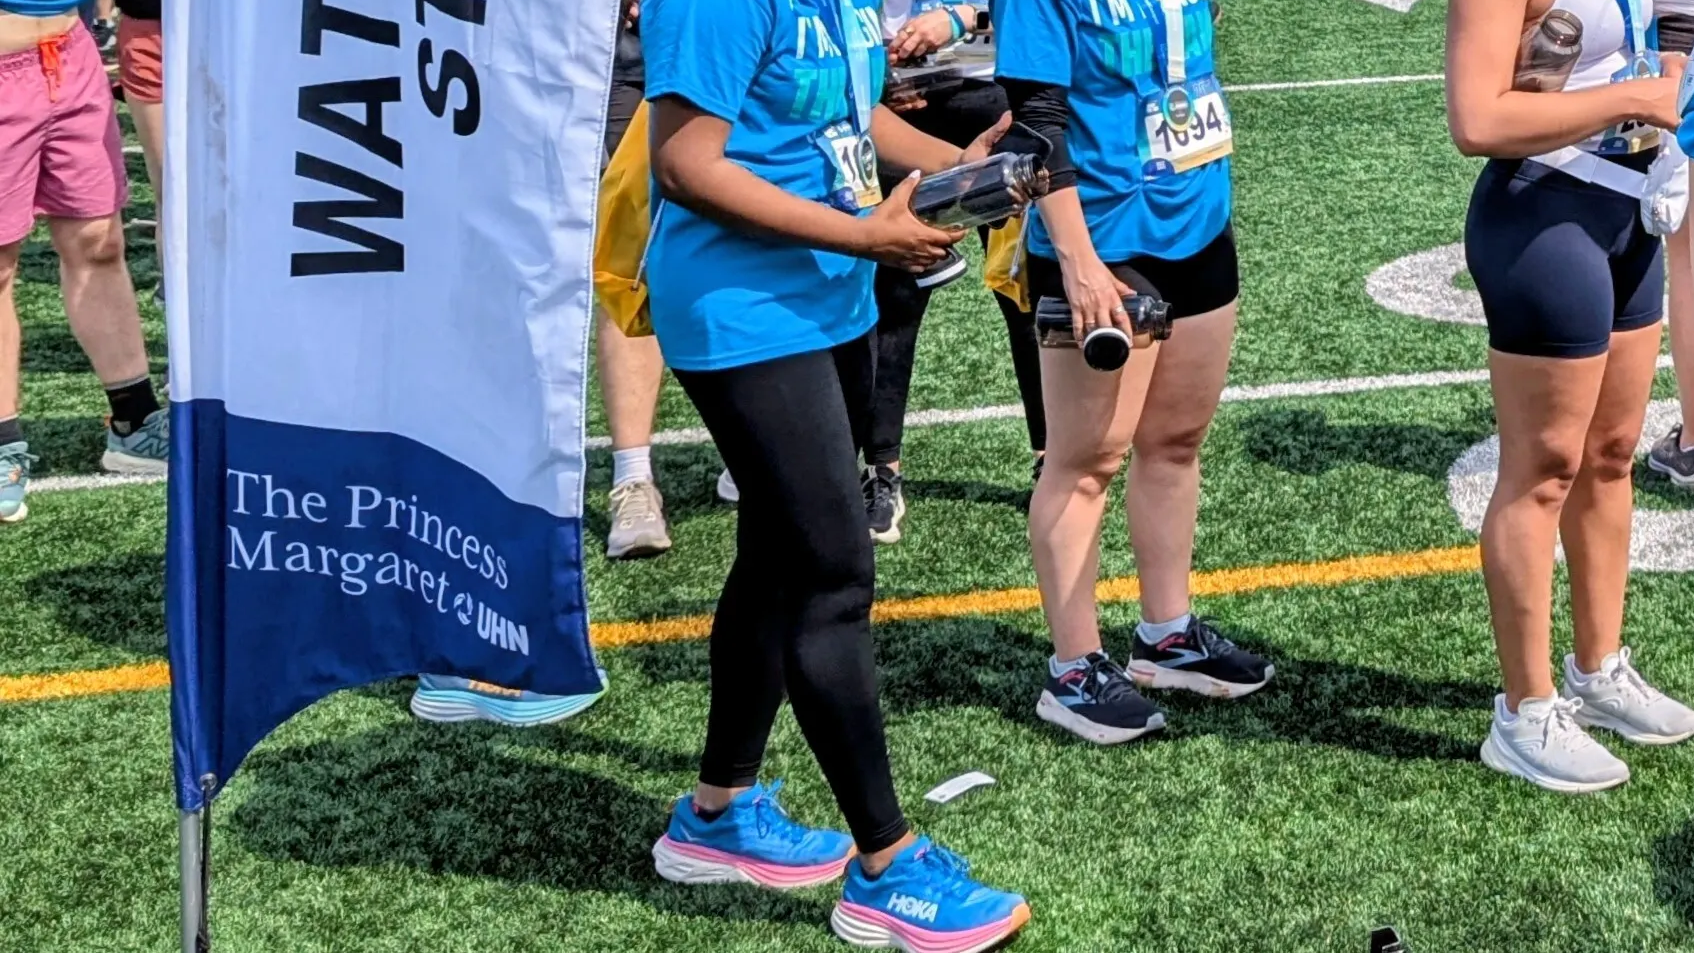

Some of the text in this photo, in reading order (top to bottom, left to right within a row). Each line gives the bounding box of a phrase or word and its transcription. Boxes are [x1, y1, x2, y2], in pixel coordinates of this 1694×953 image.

[226, 468, 509, 590] The Princess
[226, 525, 530, 657] Margaret UHN
[886, 892, 940, 923] HOKA
